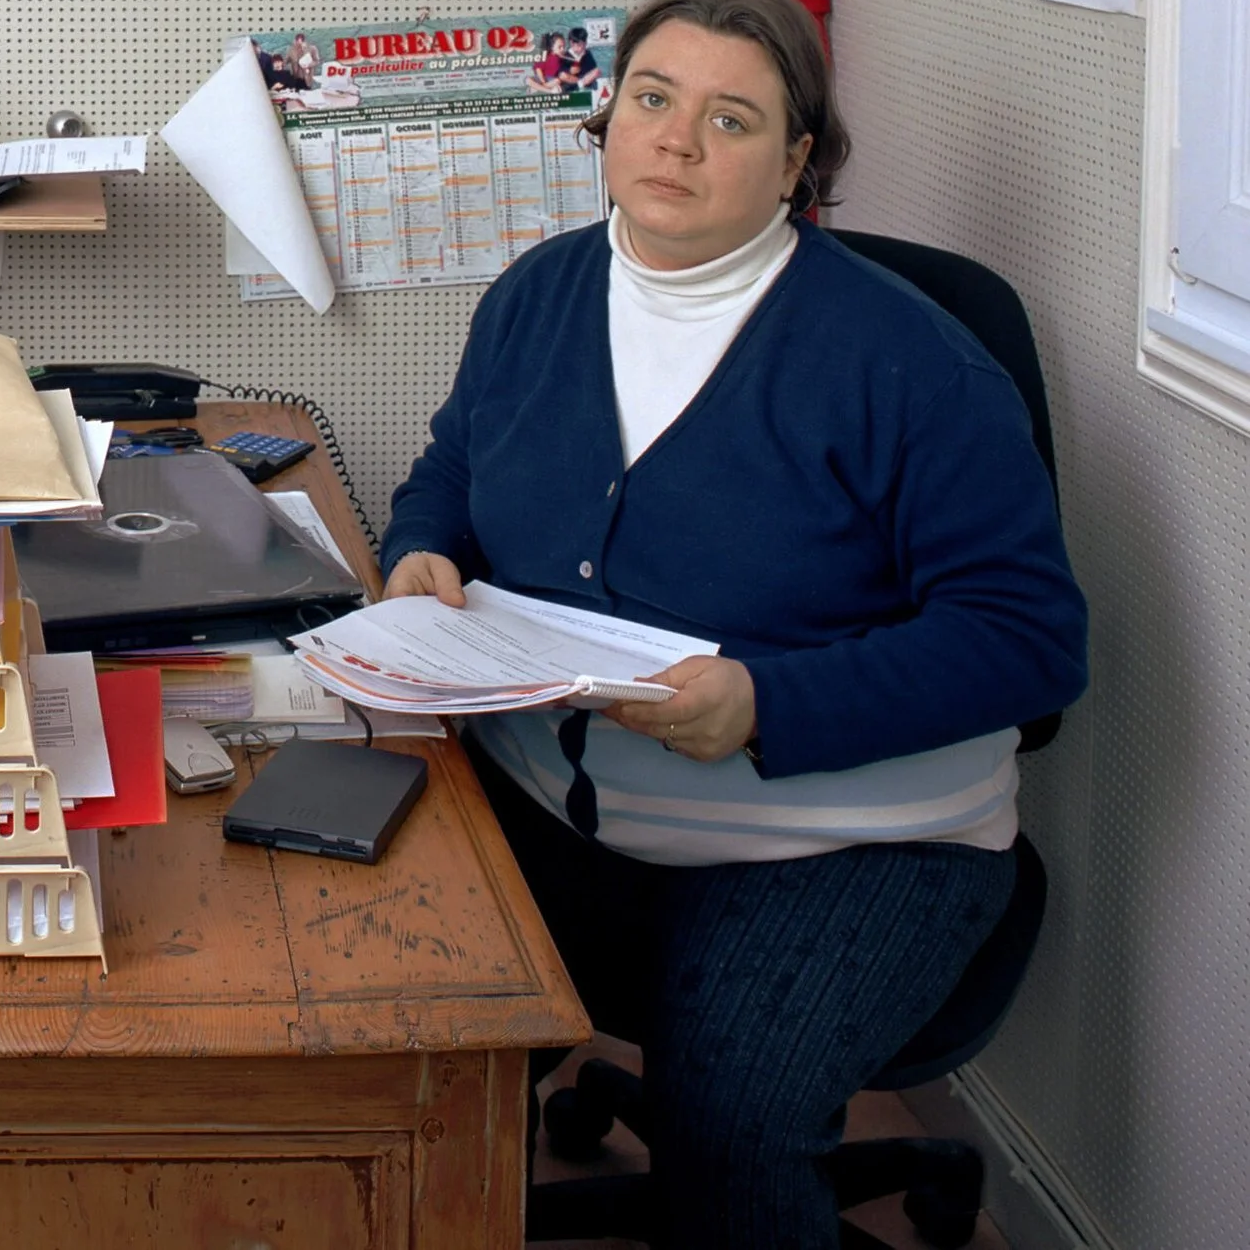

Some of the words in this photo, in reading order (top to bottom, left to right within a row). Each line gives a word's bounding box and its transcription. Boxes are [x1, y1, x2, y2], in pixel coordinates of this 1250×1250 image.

[333, 29, 481, 63] BUREAU
[486, 25, 533, 51] 02
[327, 65, 346, 78] Du
[349, 60, 425, 78] particulier
[429, 59, 448, 70] au
[451, 50, 548, 71] professionnel
